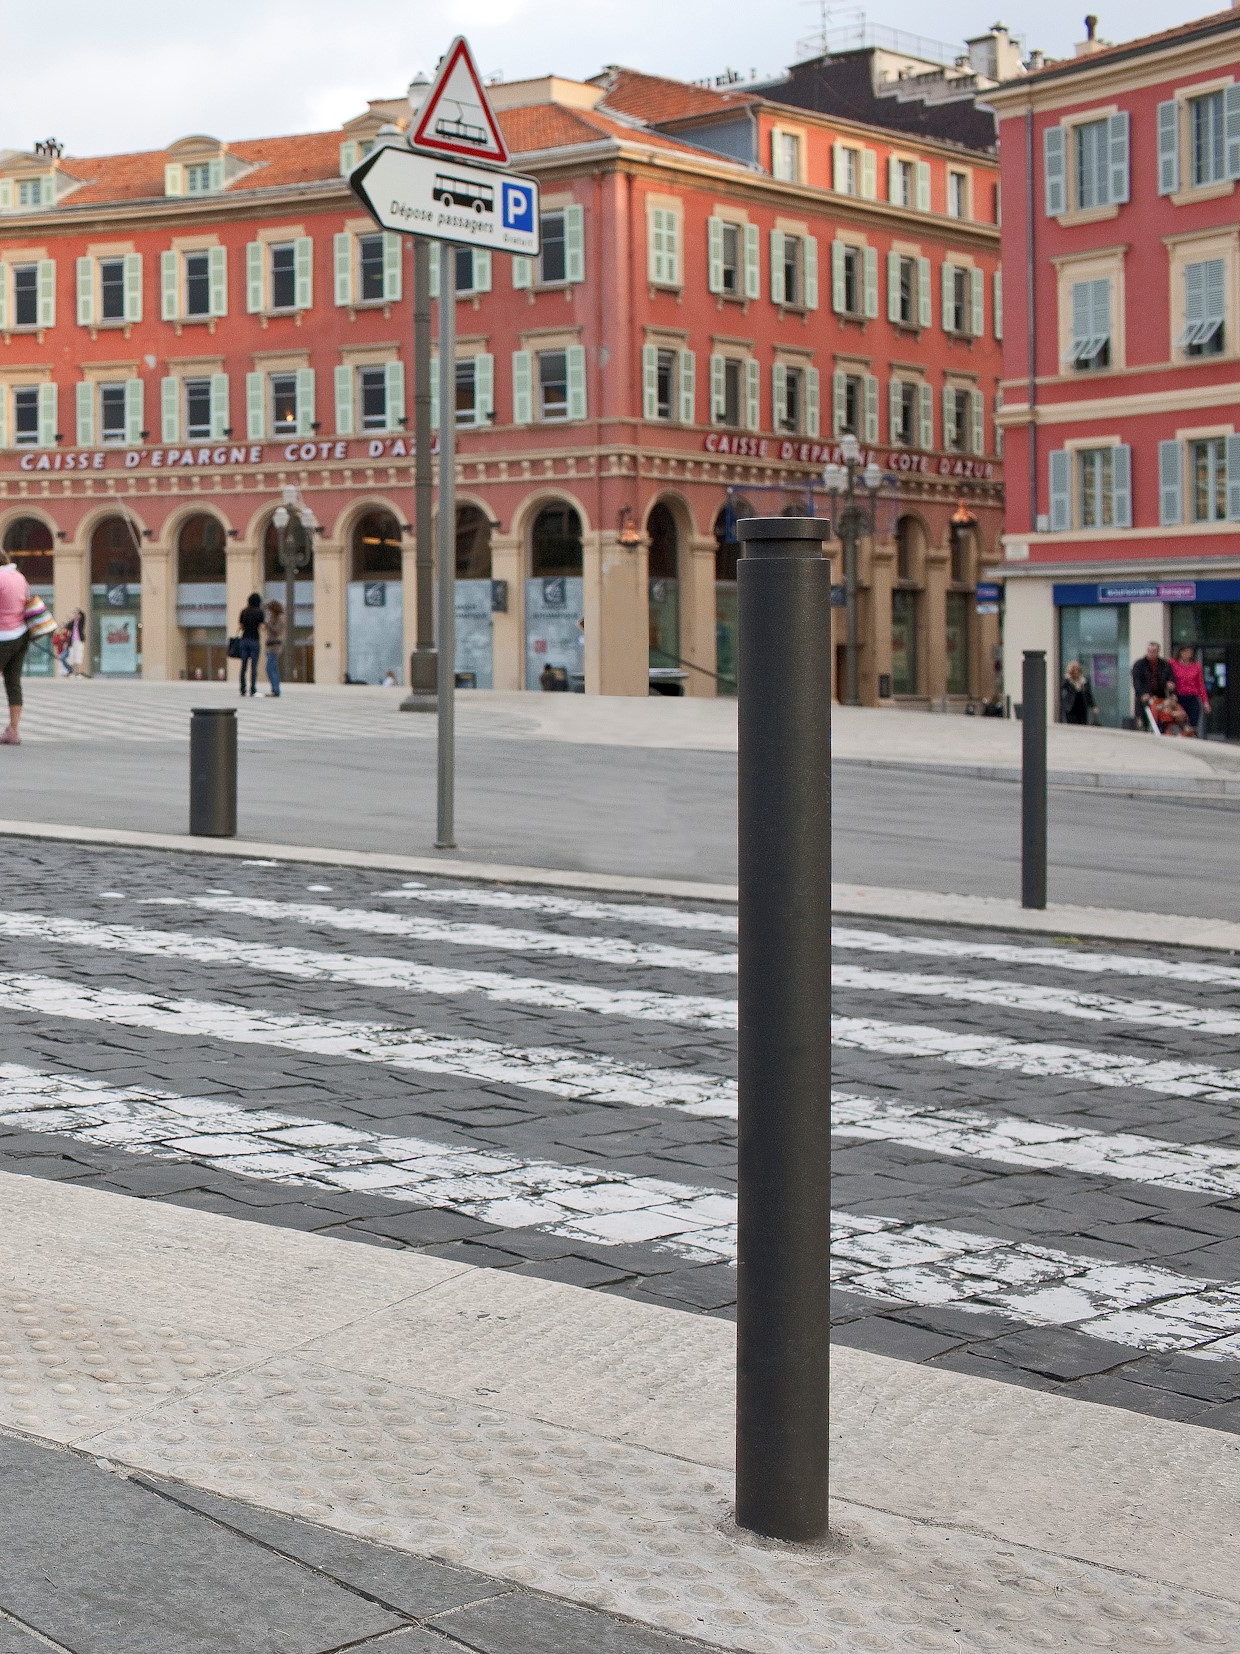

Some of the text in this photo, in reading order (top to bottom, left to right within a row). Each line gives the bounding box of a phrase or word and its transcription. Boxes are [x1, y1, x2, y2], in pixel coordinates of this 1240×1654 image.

[390, 200, 494, 234] Dépose passagers
[507, 188, 527, 225] P
[20, 437, 442, 471] CAISSE D'EPARGNE COTE D'AU
[705, 433, 767, 458] CAISSE
[781, 441, 876, 466] D'EPARNE
[889, 452, 928, 474] COTE
